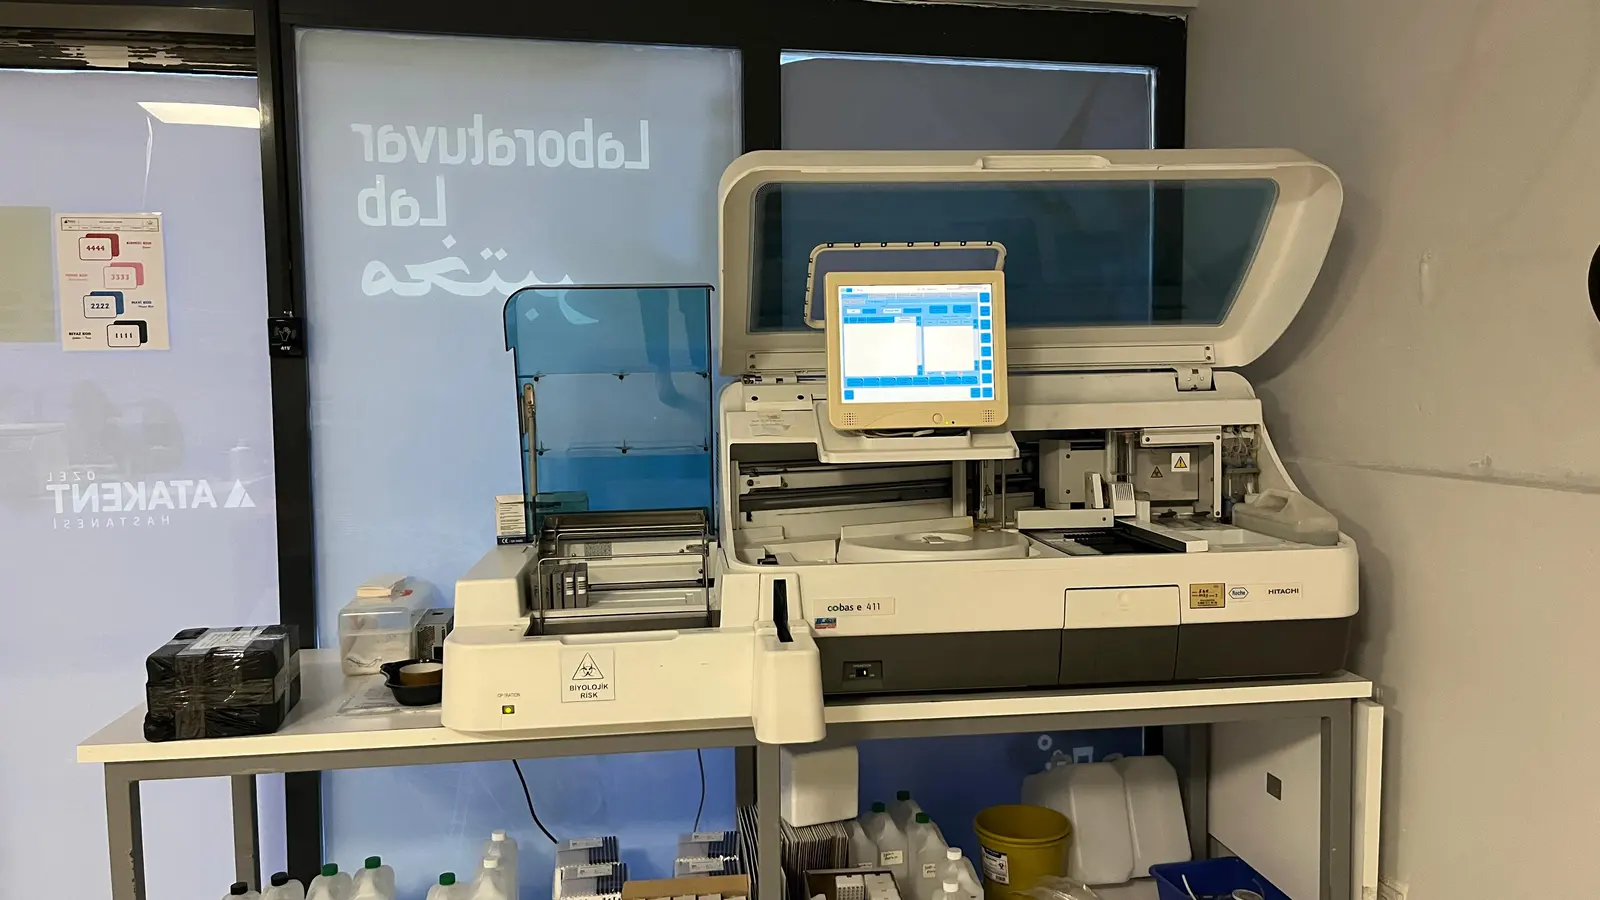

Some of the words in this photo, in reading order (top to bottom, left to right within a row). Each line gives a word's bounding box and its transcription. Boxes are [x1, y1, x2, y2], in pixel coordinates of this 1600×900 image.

[111, 273, 130, 281] 3333
[827, 603, 854, 612] cobas
[866, 602, 881, 610] 411
